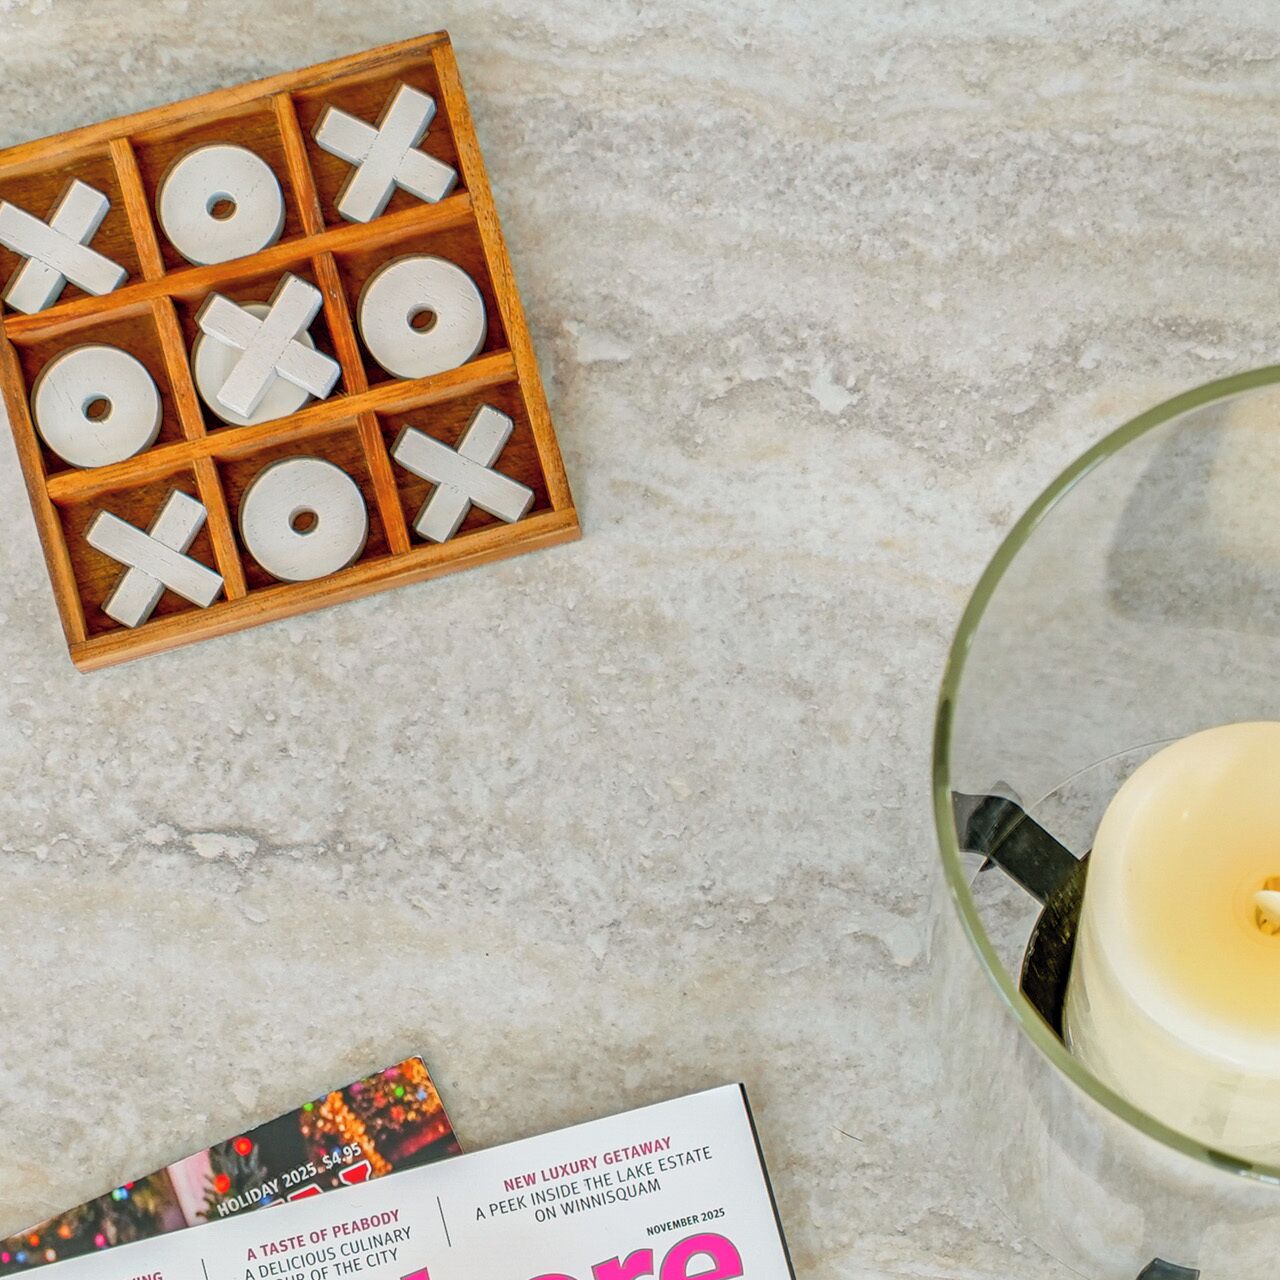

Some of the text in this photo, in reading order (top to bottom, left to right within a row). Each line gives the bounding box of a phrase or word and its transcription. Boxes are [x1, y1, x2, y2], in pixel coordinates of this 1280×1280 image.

[216, 1142, 361, 1217] HOLIDAY 2025 $4.95
[476, 1146, 713, 1221] A PEEK INSIDE THE LAKE ESTATE
[503, 1136, 672, 1192] NEW LUXURY GETAWAY
[535, 1178, 662, 1223] ON WINNISQUAM
[646, 1207, 726, 1236] NOVEMBER 2025
[247, 1209, 399, 1261] A TASTE OF PEABODY
[258, 1246, 337, 1278] DELICIOUS
[340, 1226, 412, 1256] CULINARY
[335, 1258, 363, 1276] THE
[365, 1247, 398, 1268] CITY
